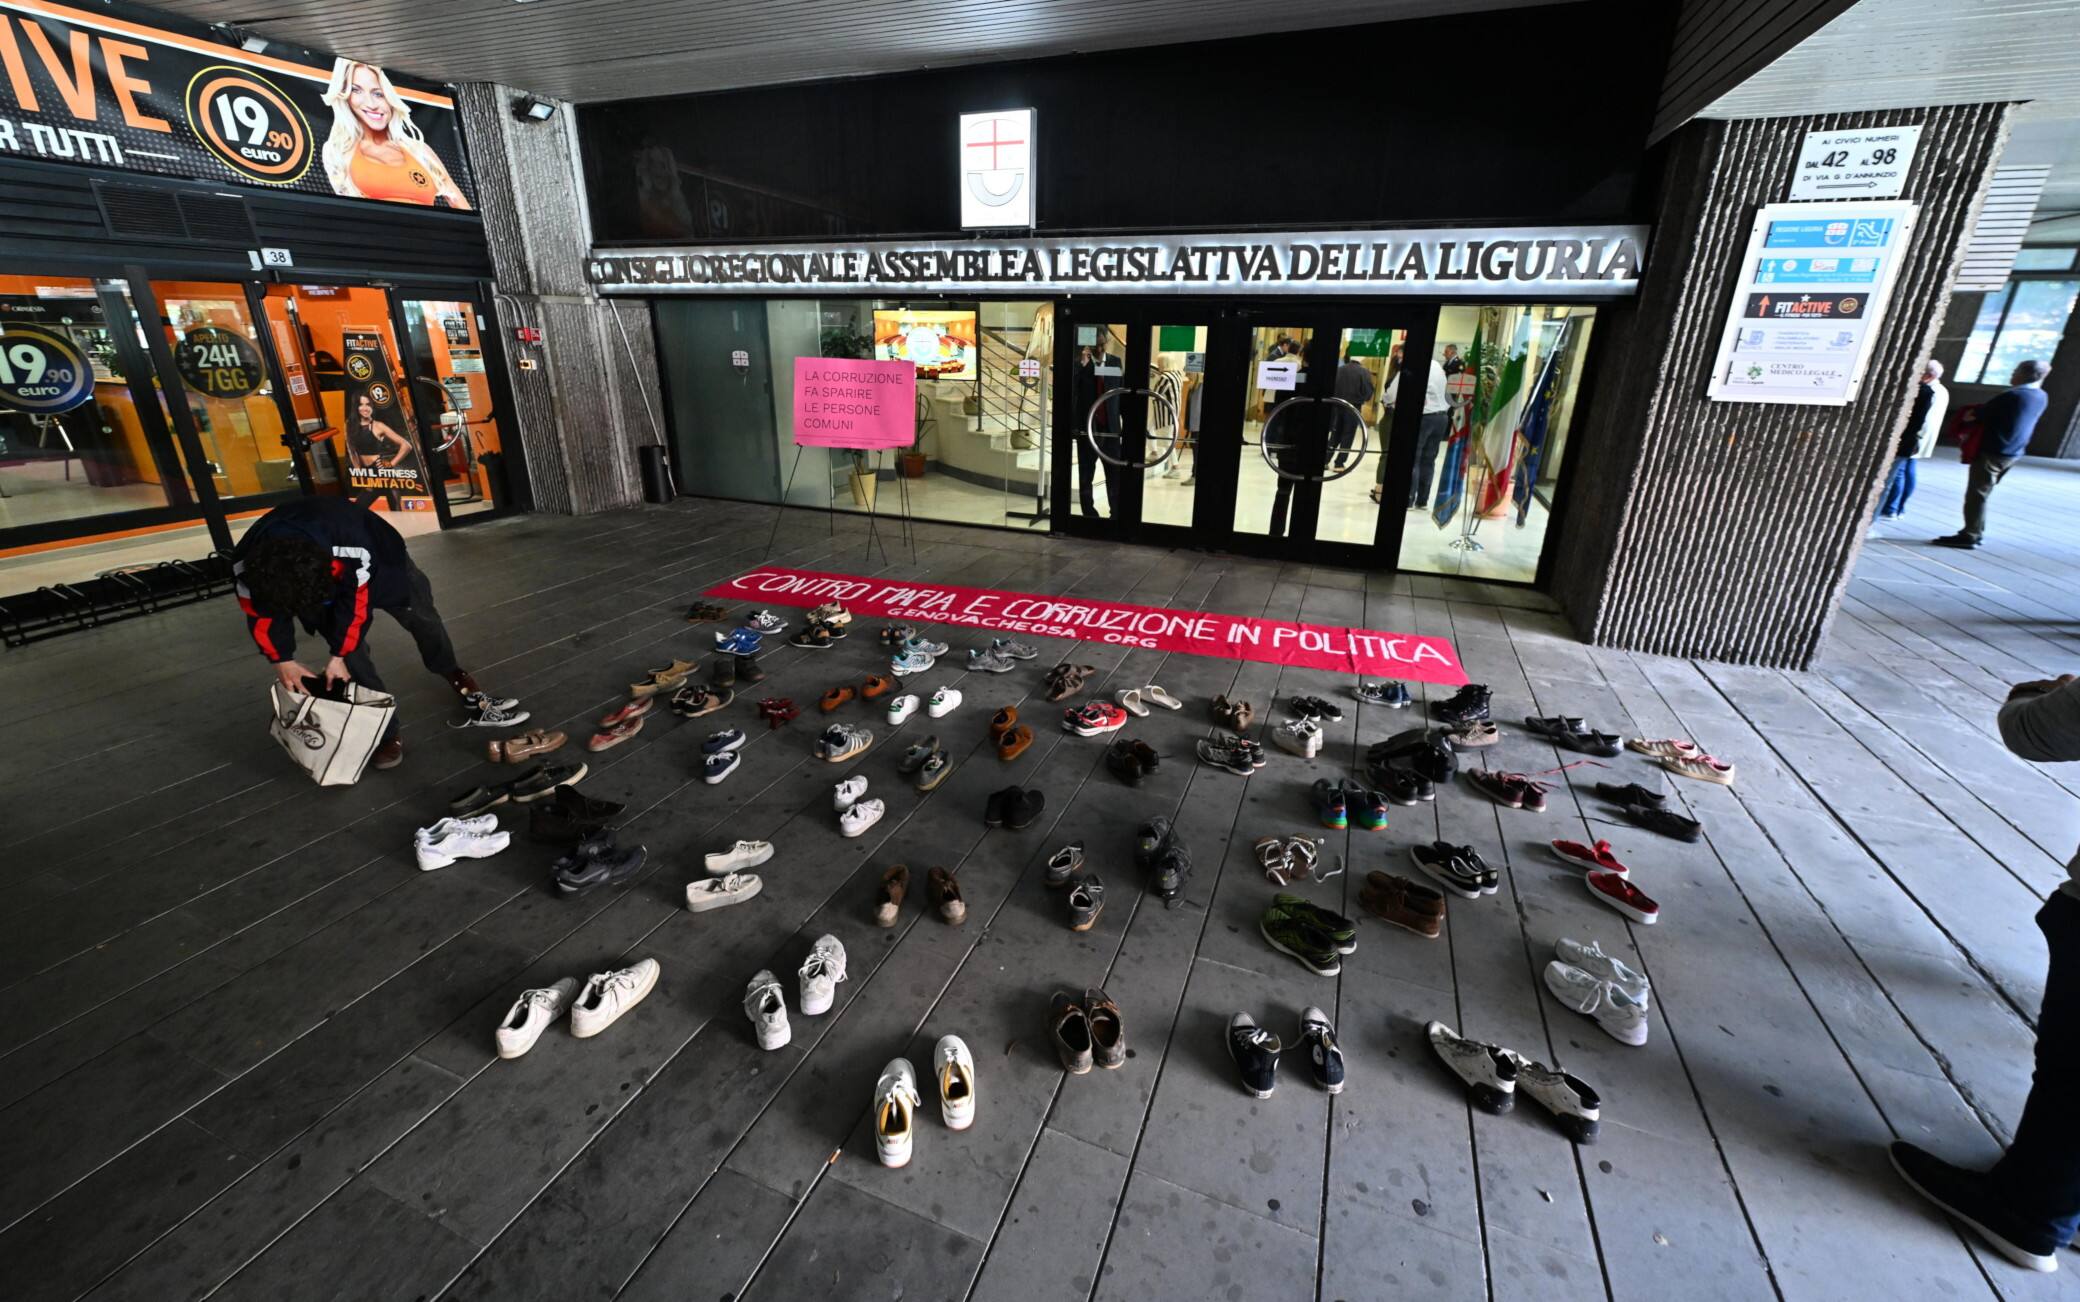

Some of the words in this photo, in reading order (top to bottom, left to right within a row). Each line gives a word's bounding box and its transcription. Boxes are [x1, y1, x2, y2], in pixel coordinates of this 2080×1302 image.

[22, 122, 124, 164] TUTTI
[240, 147, 281, 162] euro
[1822, 151, 1849, 167] 42
[1872, 148, 1897, 165] 98
[1845, 172, 1898, 180] D'ANNUNZIO
[270, 251, 287, 263] 38
[584, 255, 709, 284] CONSIGLIO
[708, 252, 857, 283] REGIONALE
[865, 249, 1044, 282] ASSEMBLEA
[1050, 245, 1281, 282] LEGISLATIVA
[1287, 242, 1428, 281] DELLA
[1434, 238, 1642, 281] LIGURIA
[1774, 302, 1832, 313] FITACTIVE
[193, 344, 241, 368] 24H
[200, 367, 249, 391] 7GG
[805, 371, 819, 381] LA
[823, 371, 903, 385] CORRUZIONE
[17, 386, 61, 396] euro
[804, 386, 819, 397] FA
[822, 387, 872, 400] SPARIRE
[804, 403, 819, 413] LE
[823, 403, 880, 416] PERSONE
[803, 418, 854, 431] COMUNI
[349, 468, 367, 477] VIVI
[368, 468, 377, 477] IL
[378, 468, 418, 479] FITNESS
[351, 477, 416, 490] ILLIMITATO
[732, 573, 871, 600] CONTRO
[867, 586, 957, 611] MAFIA
[963, 596, 1000, 616] E
[1001, 599, 1221, 641] CORRUZIONE
[1227, 623, 1262, 647] IN
[1273, 627, 1453, 666] POLITICA
